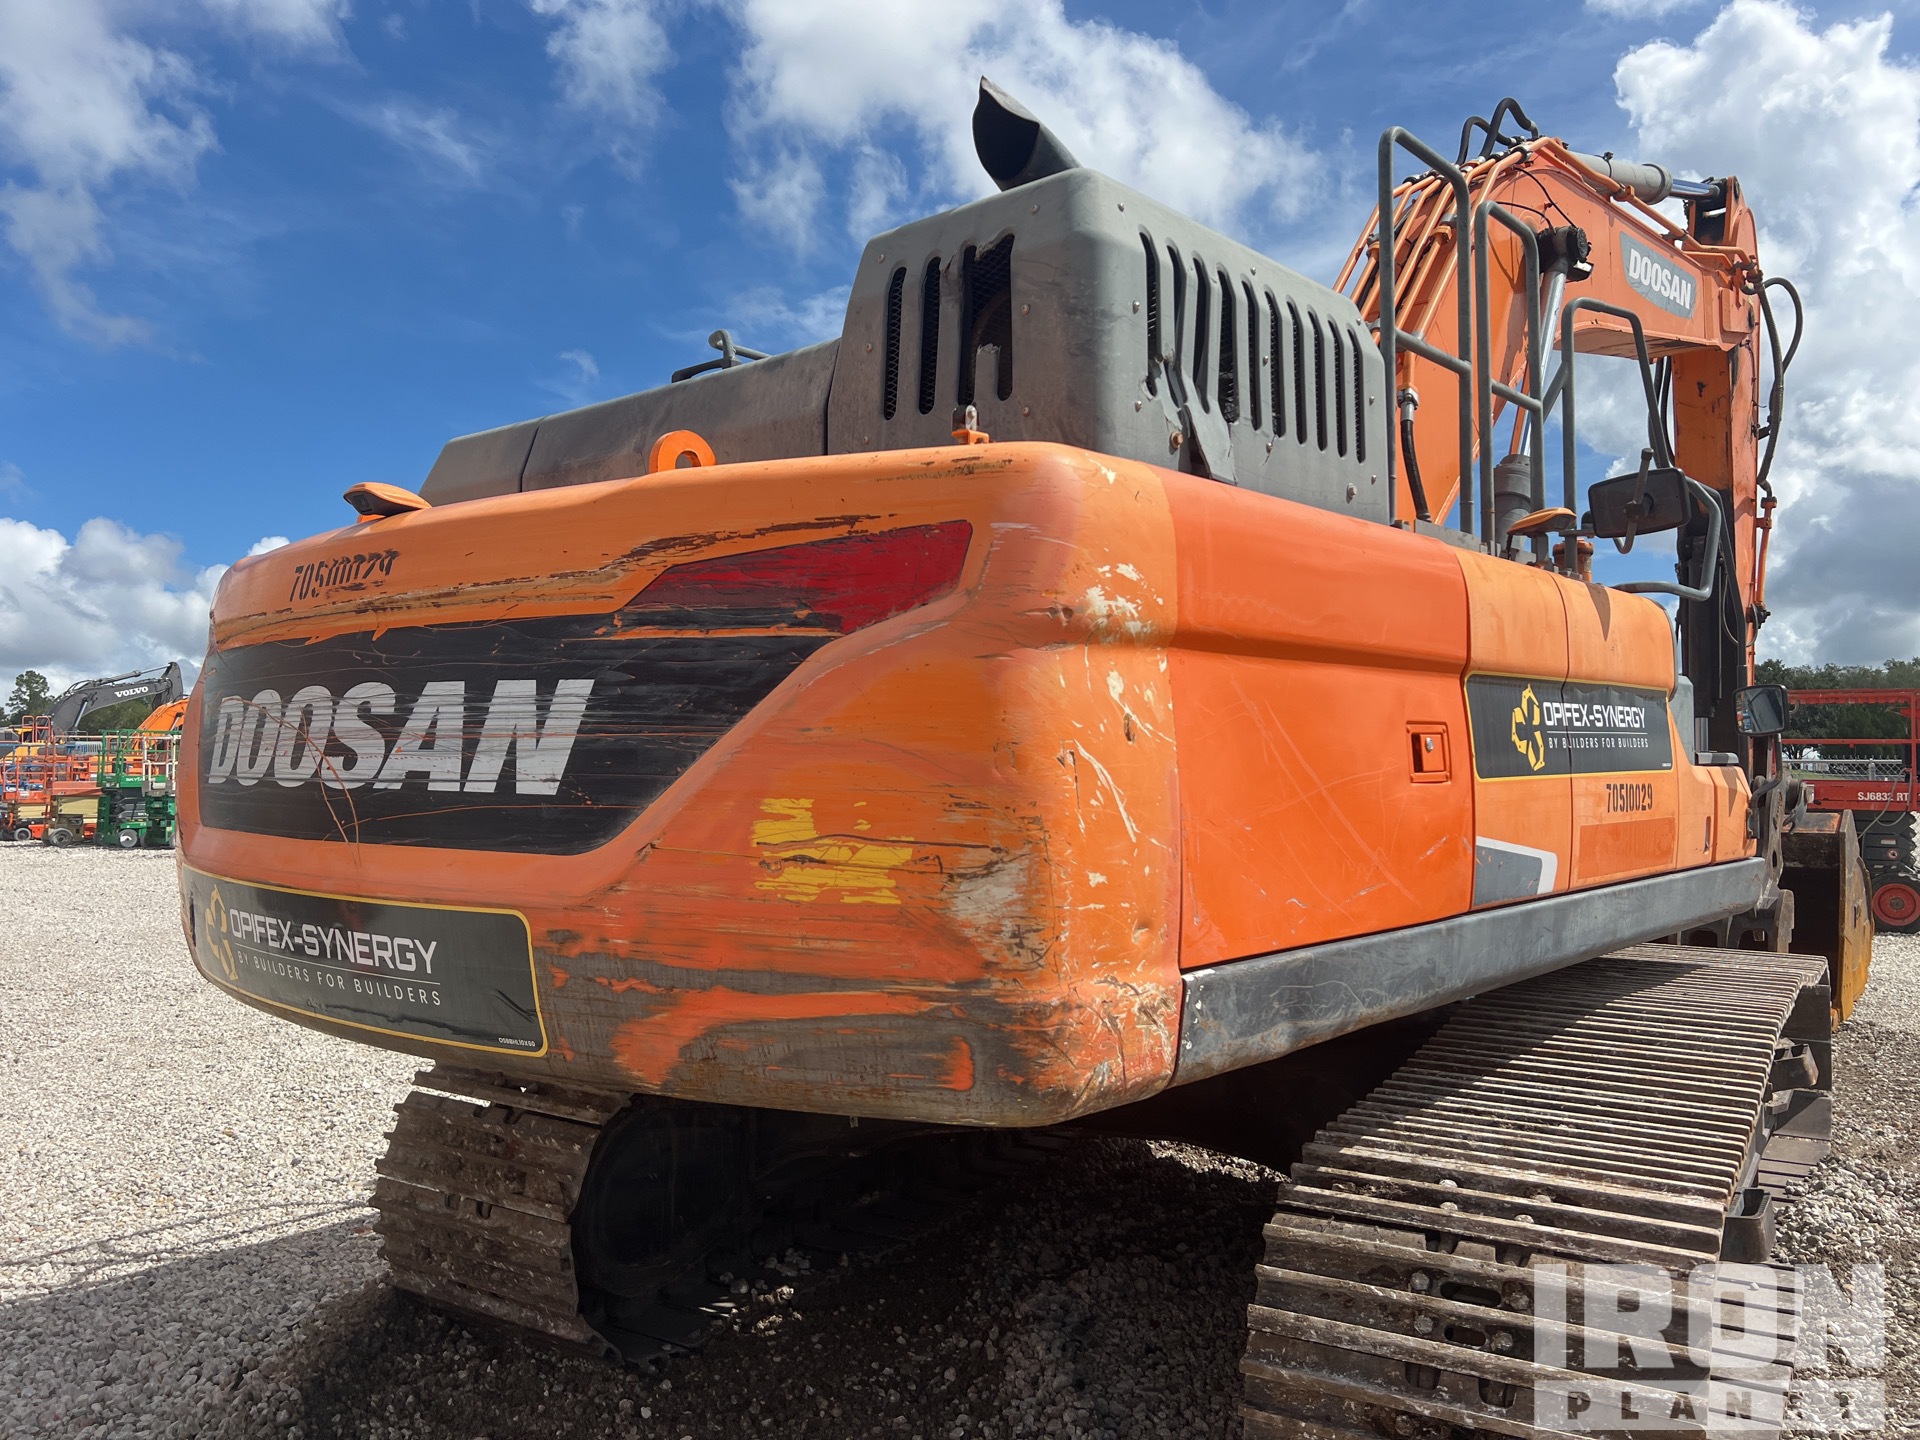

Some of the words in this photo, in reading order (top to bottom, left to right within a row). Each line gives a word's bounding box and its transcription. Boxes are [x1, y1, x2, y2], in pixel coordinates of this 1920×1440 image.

[1629, 248, 1692, 309] DOOSAN
[114, 686, 149, 698] VOLVO
[1543, 702, 1646, 729] OPIFEX-SYNERGY
[207, 679, 595, 796] DOOSAN
[1548, 737, 1558, 749] BY
[1602, 737, 1616, 748] FOR
[1618, 737, 1649, 748] BUILDERS
[1606, 783, 1653, 814] 70510029
[1857, 791, 1894, 801] SJ6832
[1896, 792, 1909, 801] RT
[229, 908, 437, 974] OPIFEX-SYNERGY
[237, 950, 250, 966] BY
[254, 957, 310, 983] BUILDERS
[317, 971, 345, 991] FOR
[354, 979, 441, 1006] BUILDERS
